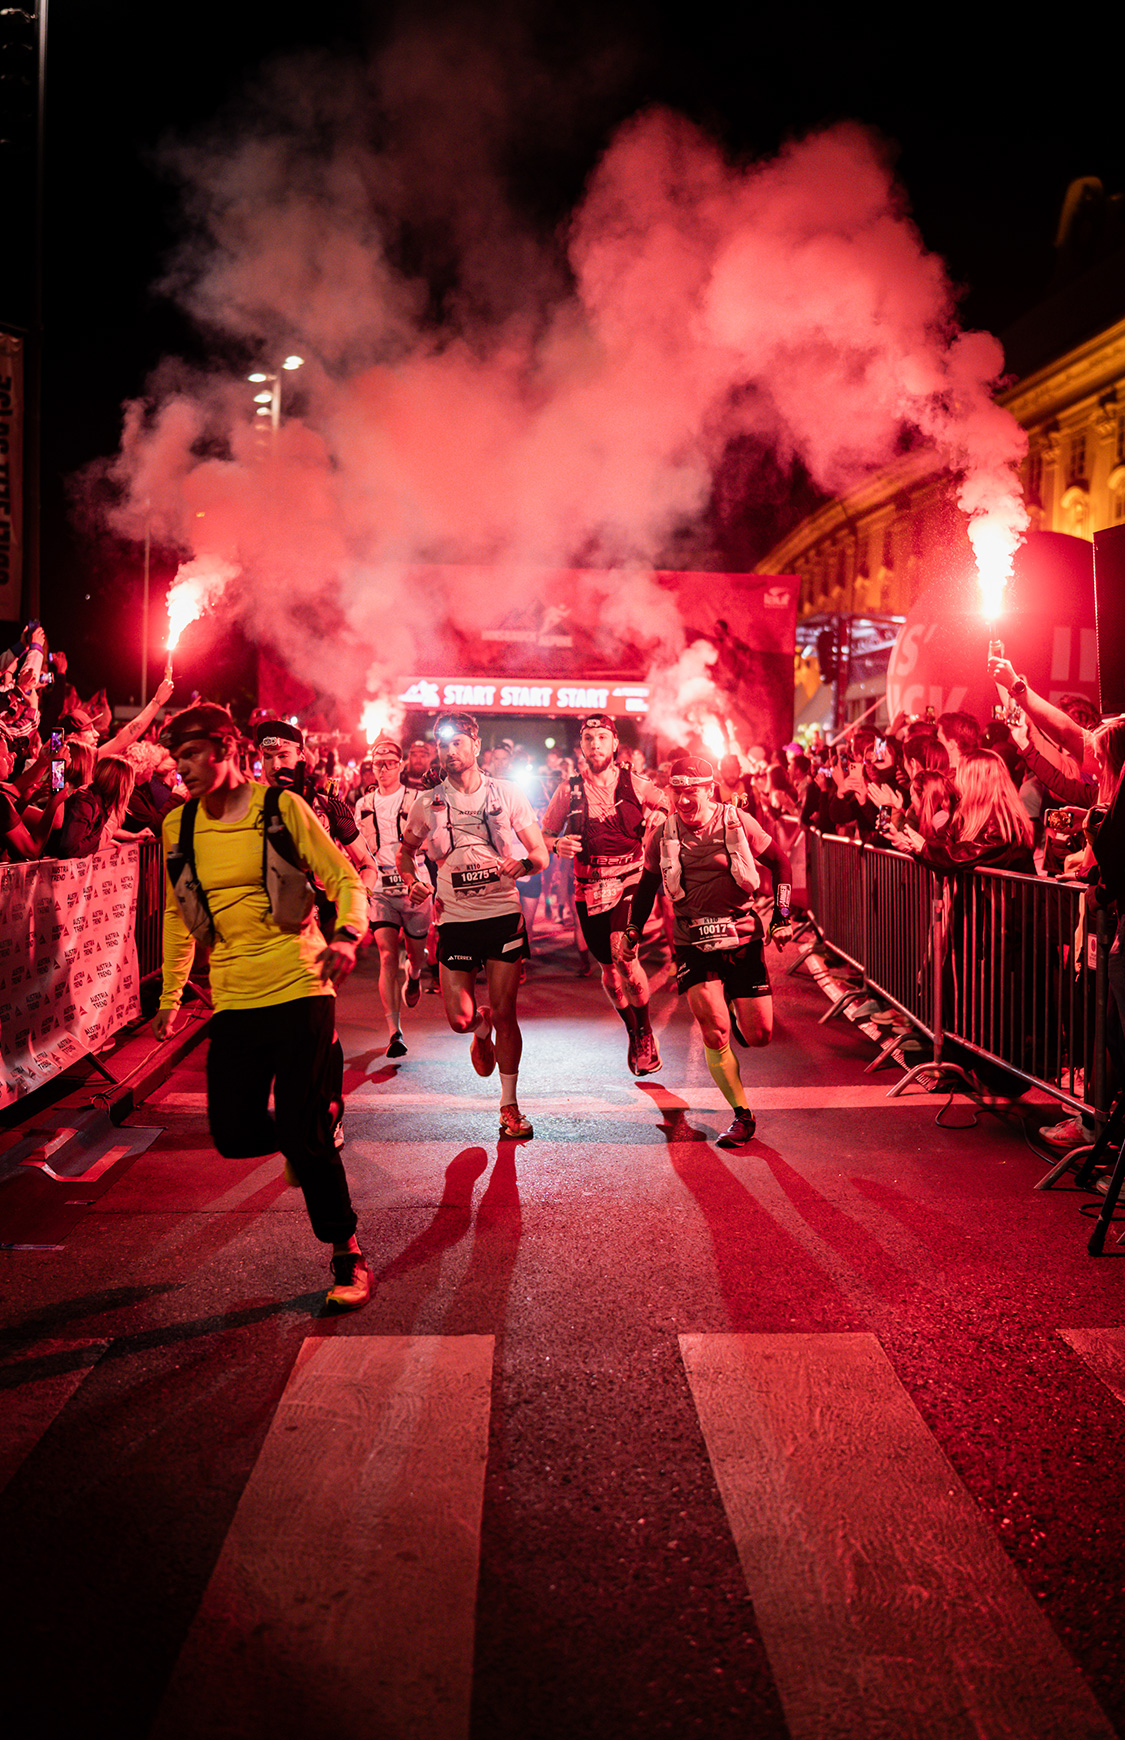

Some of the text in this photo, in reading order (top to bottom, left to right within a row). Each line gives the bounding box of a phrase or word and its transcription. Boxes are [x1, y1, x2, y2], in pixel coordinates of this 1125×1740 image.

[444, 685, 496, 706] START
[500, 686, 553, 707] START
[556, 687, 609, 709] START
[52, 866, 68, 874] AUSTRIA
[51, 874, 66, 882] TREND
[461, 870, 489, 882] 10275
[699, 924, 727, 936] 10017
[105, 932, 120, 940] AUSTRIA
[106, 940, 119, 948] TREND
[96, 962, 112, 971] AUSTRIA
[98, 970, 112, 978] TREND
[90, 991, 108, 1002] AUSTRIA
[92, 1000, 107, 1009] TREND
